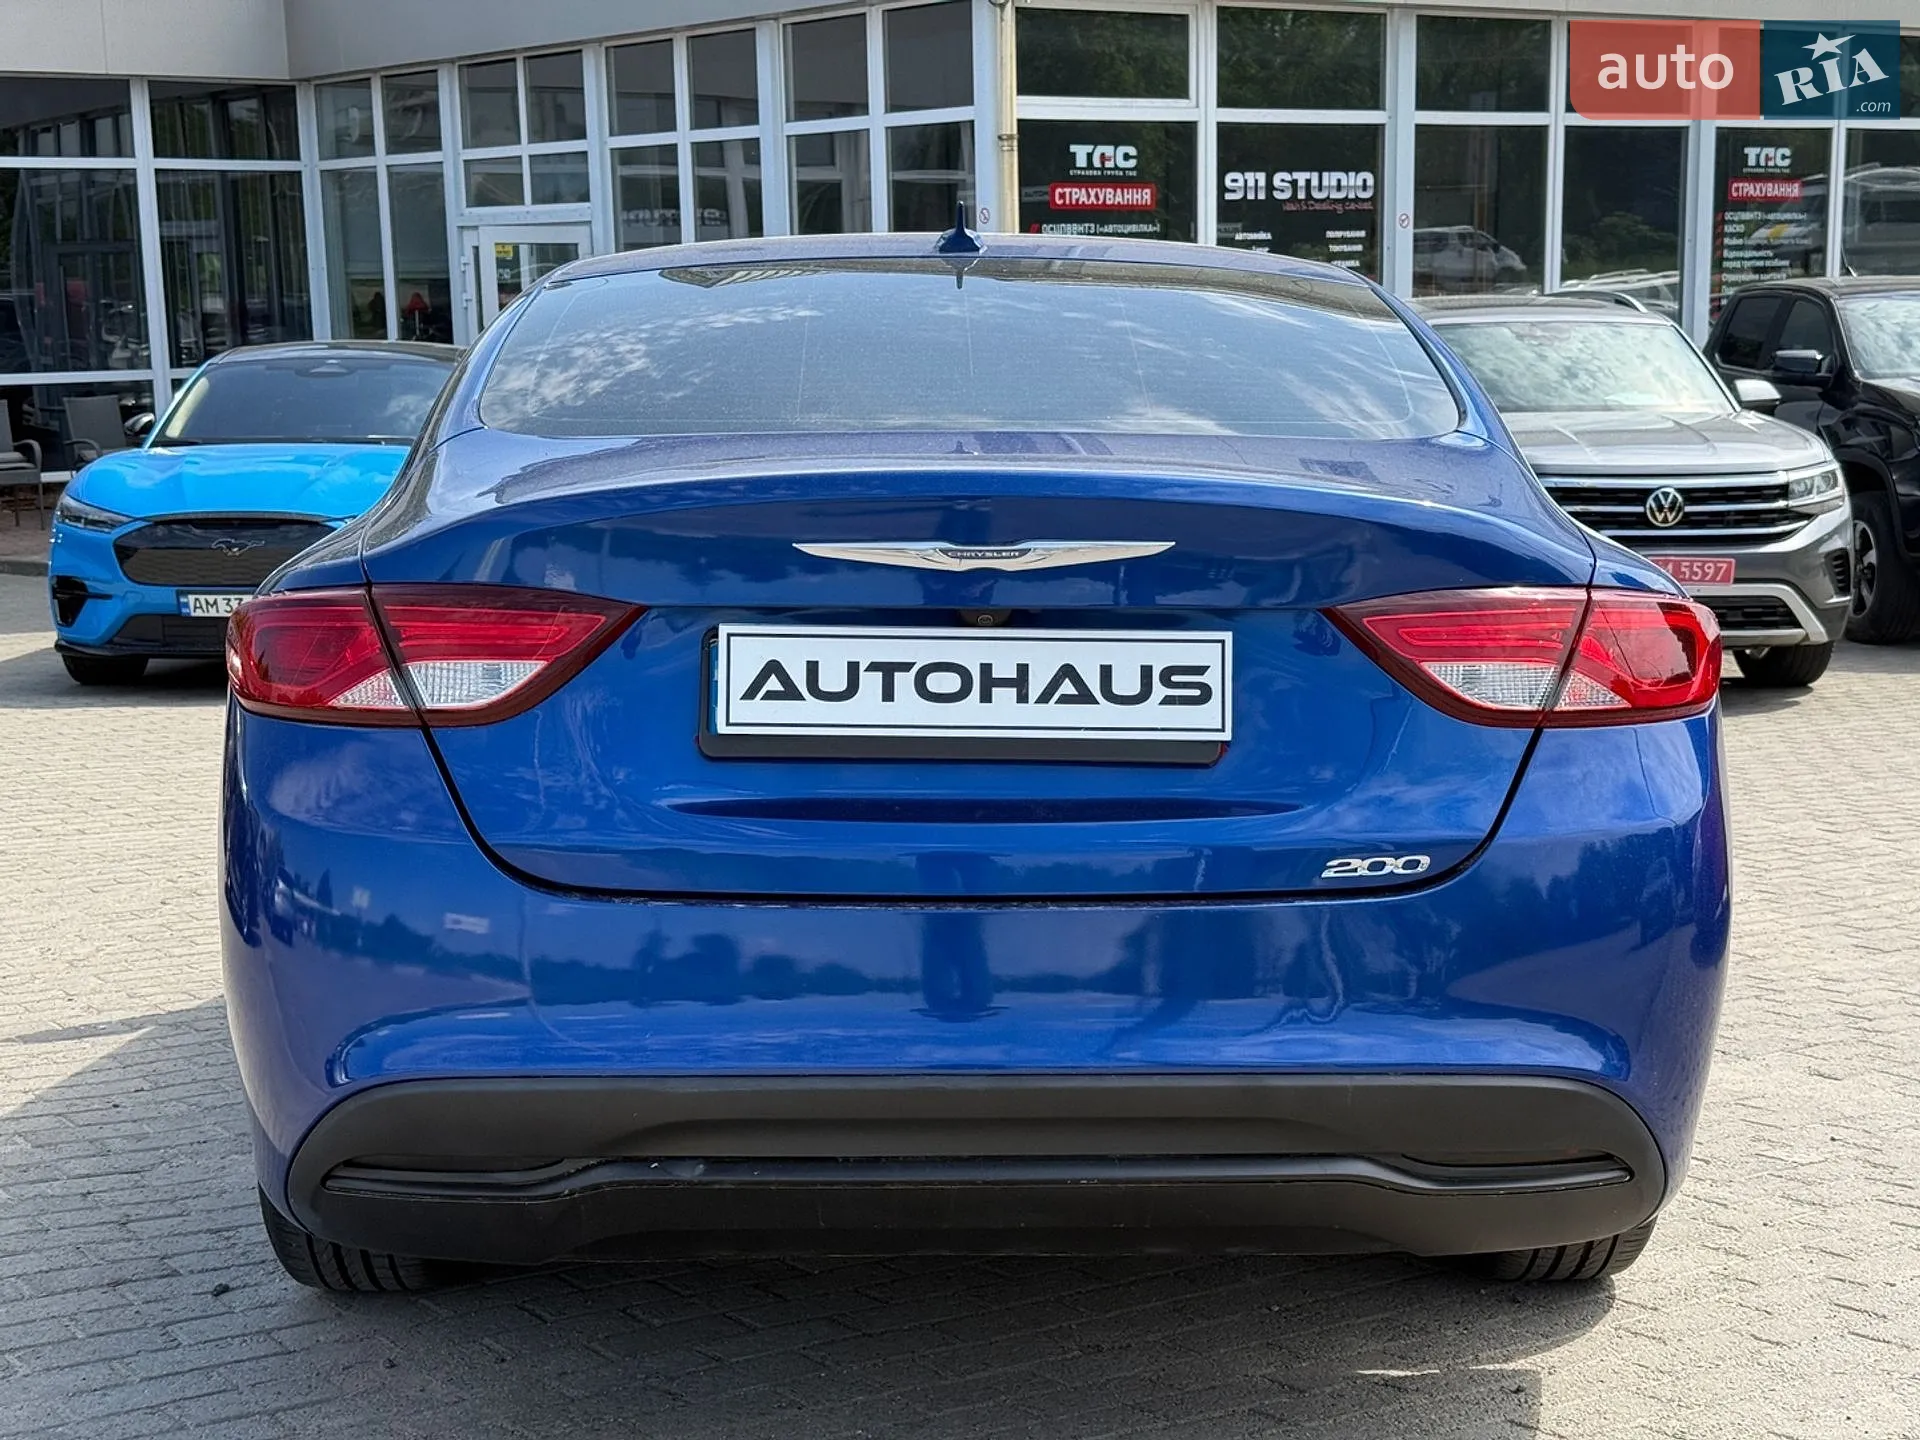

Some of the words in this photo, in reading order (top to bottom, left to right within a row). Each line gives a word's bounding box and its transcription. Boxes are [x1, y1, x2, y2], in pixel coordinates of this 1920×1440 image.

[1054, 188, 1151, 205] СТРАХУВАННЯ
[1224, 172, 1267, 200] 911
[1272, 171, 1375, 200] STUDIO
[1731, 183, 1799, 197] СТРАХУВАННЯ
[1680, 561, 1728, 582] 5597
[739, 658, 1214, 707] AUTOHAUS
[1321, 855, 1431, 878] 200
